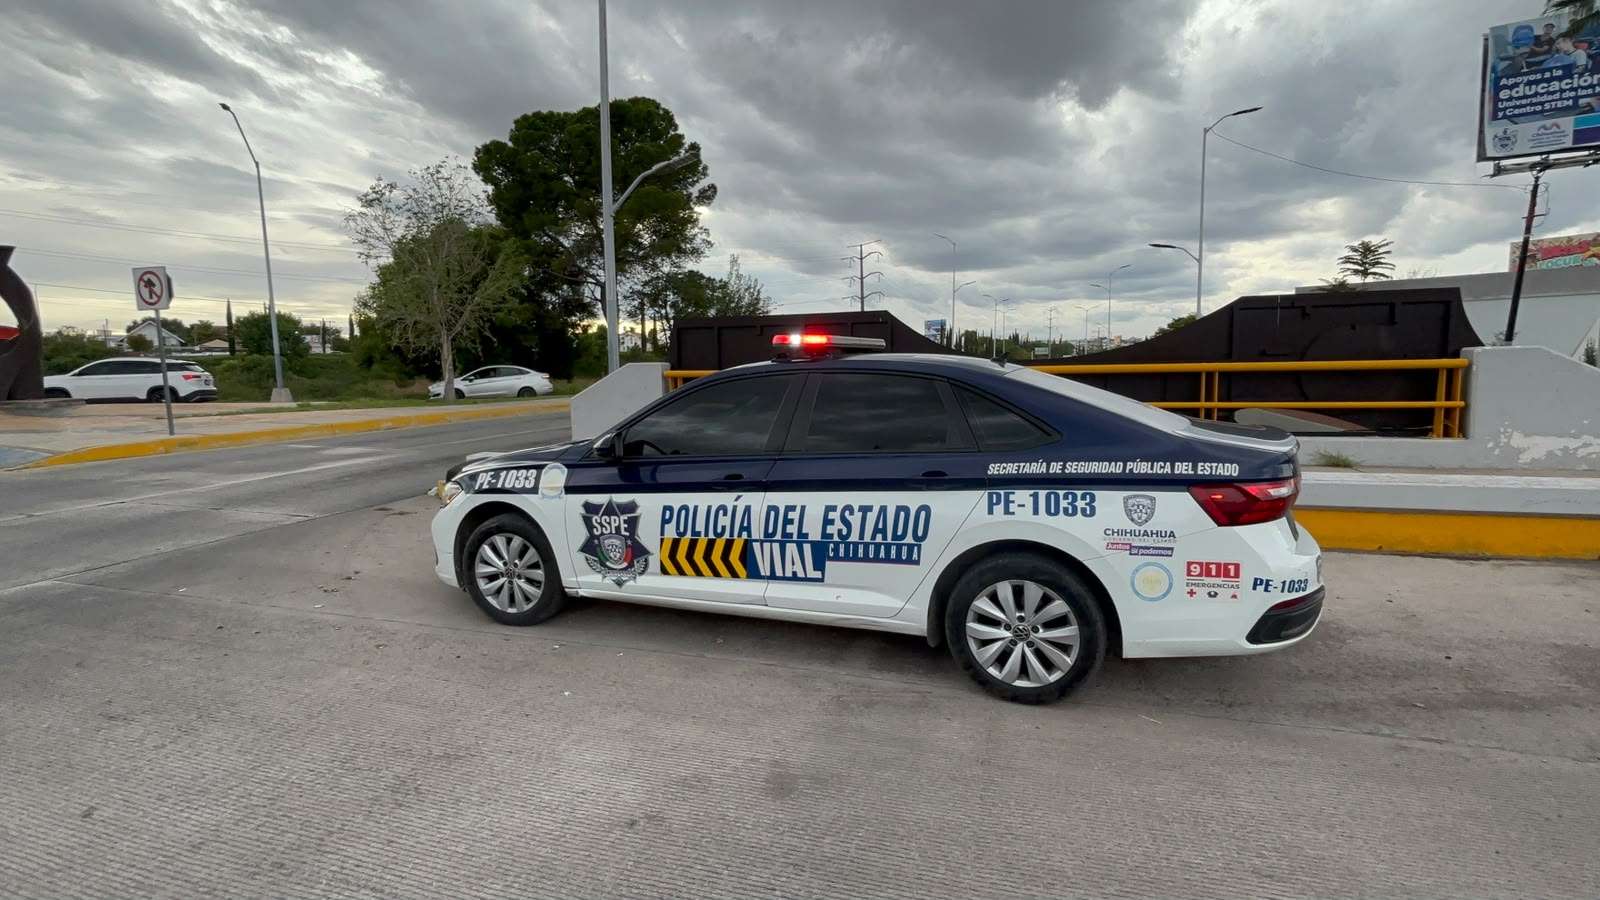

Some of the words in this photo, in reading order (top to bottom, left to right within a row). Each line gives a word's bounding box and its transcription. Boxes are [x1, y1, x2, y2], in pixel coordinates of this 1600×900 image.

[1499, 72, 1600, 99] educación
[1500, 73, 1542, 86] Apoyos
[1552, 69, 1563, 77] la
[1498, 92, 1560, 108] Universidad
[1561, 90, 1576, 98] de
[1577, 88, 1593, 96] las
[1497, 111, 1504, 119] y
[1505, 105, 1542, 116] Centro
[1543, 99, 1573, 110] STEM
[987, 459, 1047, 475] SECRETARÍA
[1048, 461, 1063, 474] DE
[1065, 461, 1123, 474] SEGURIDAD
[1126, 459, 1171, 474] PÚBLICA
[1174, 462, 1195, 474] DEL
[1197, 462, 1239, 476] ESTADO
[475, 469, 537, 490] PE-1033
[987, 491, 1097, 518] PE-1033
[592, 515, 630, 536] SSPE
[660, 495, 751, 538] POLICÍA
[763, 504, 809, 540] DEL
[821, 504, 932, 543] ESTADO
[1103, 528, 1177, 539] CHIHUAHUA
[752, 541, 822, 579] VIAL
[829, 543, 918, 560] CHIHUAHUA
[1189, 563, 1235, 577] 911
[1185, 582, 1240, 590] EMERGENCIAS
[1252, 577, 1309, 594] PE-1033
